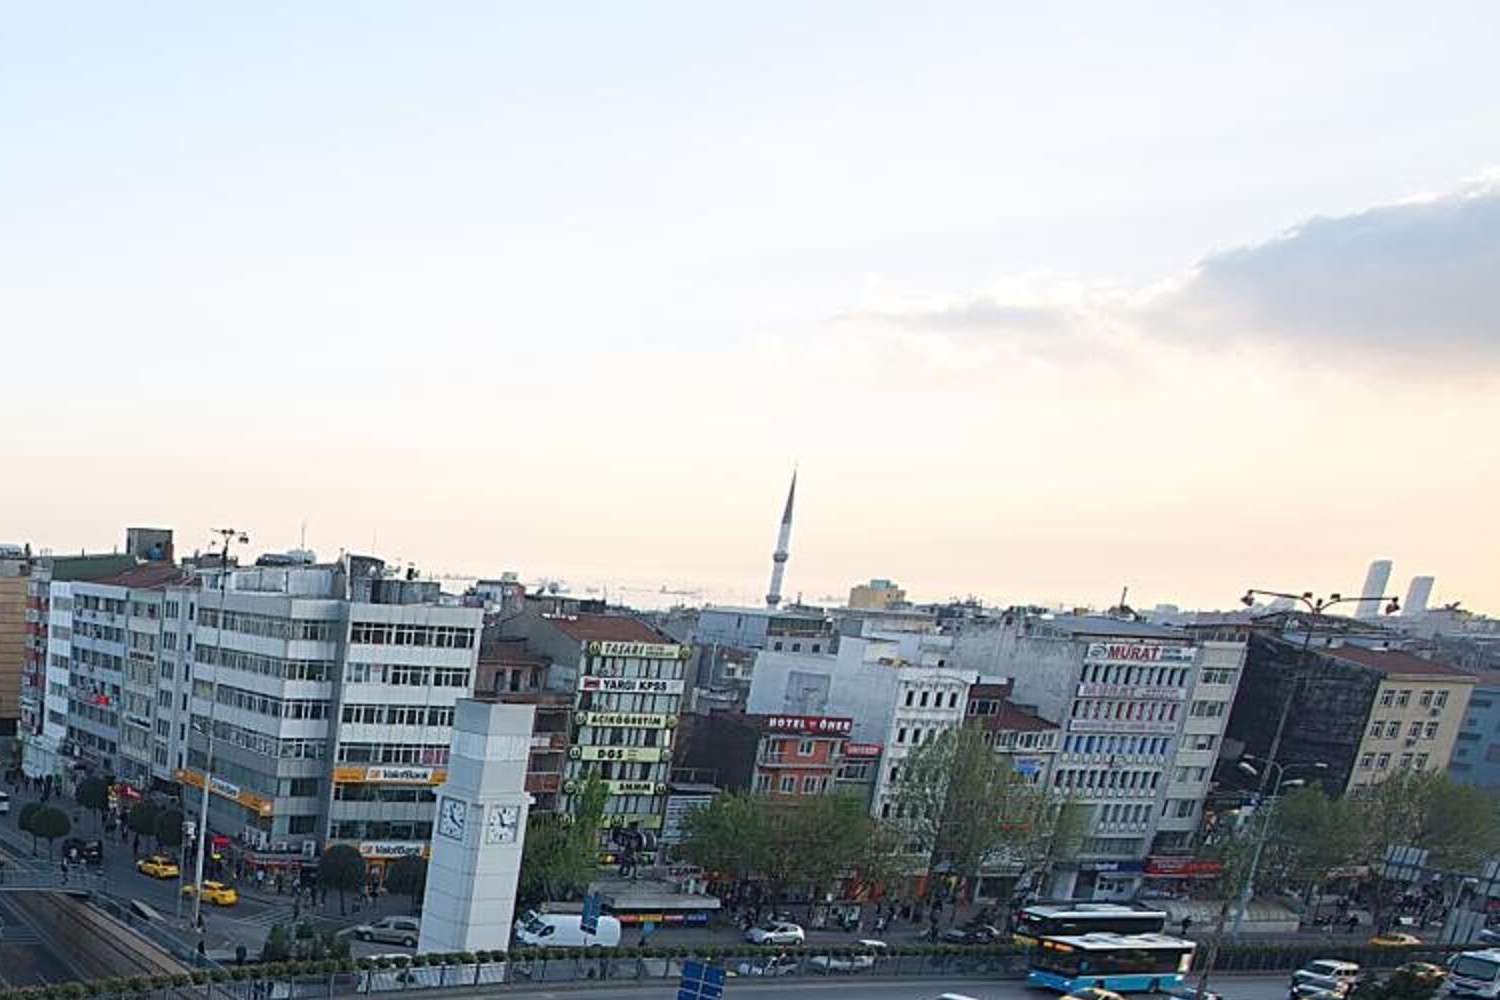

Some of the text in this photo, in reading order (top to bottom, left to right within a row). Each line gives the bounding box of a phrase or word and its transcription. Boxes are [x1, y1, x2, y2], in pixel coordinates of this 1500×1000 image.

[1108, 645, 1159, 660] MURAT
[639, 681, 667, 692] KPSS
[769, 717, 851, 731] HOTEL ÖNER
[597, 749, 623, 759] DGS
